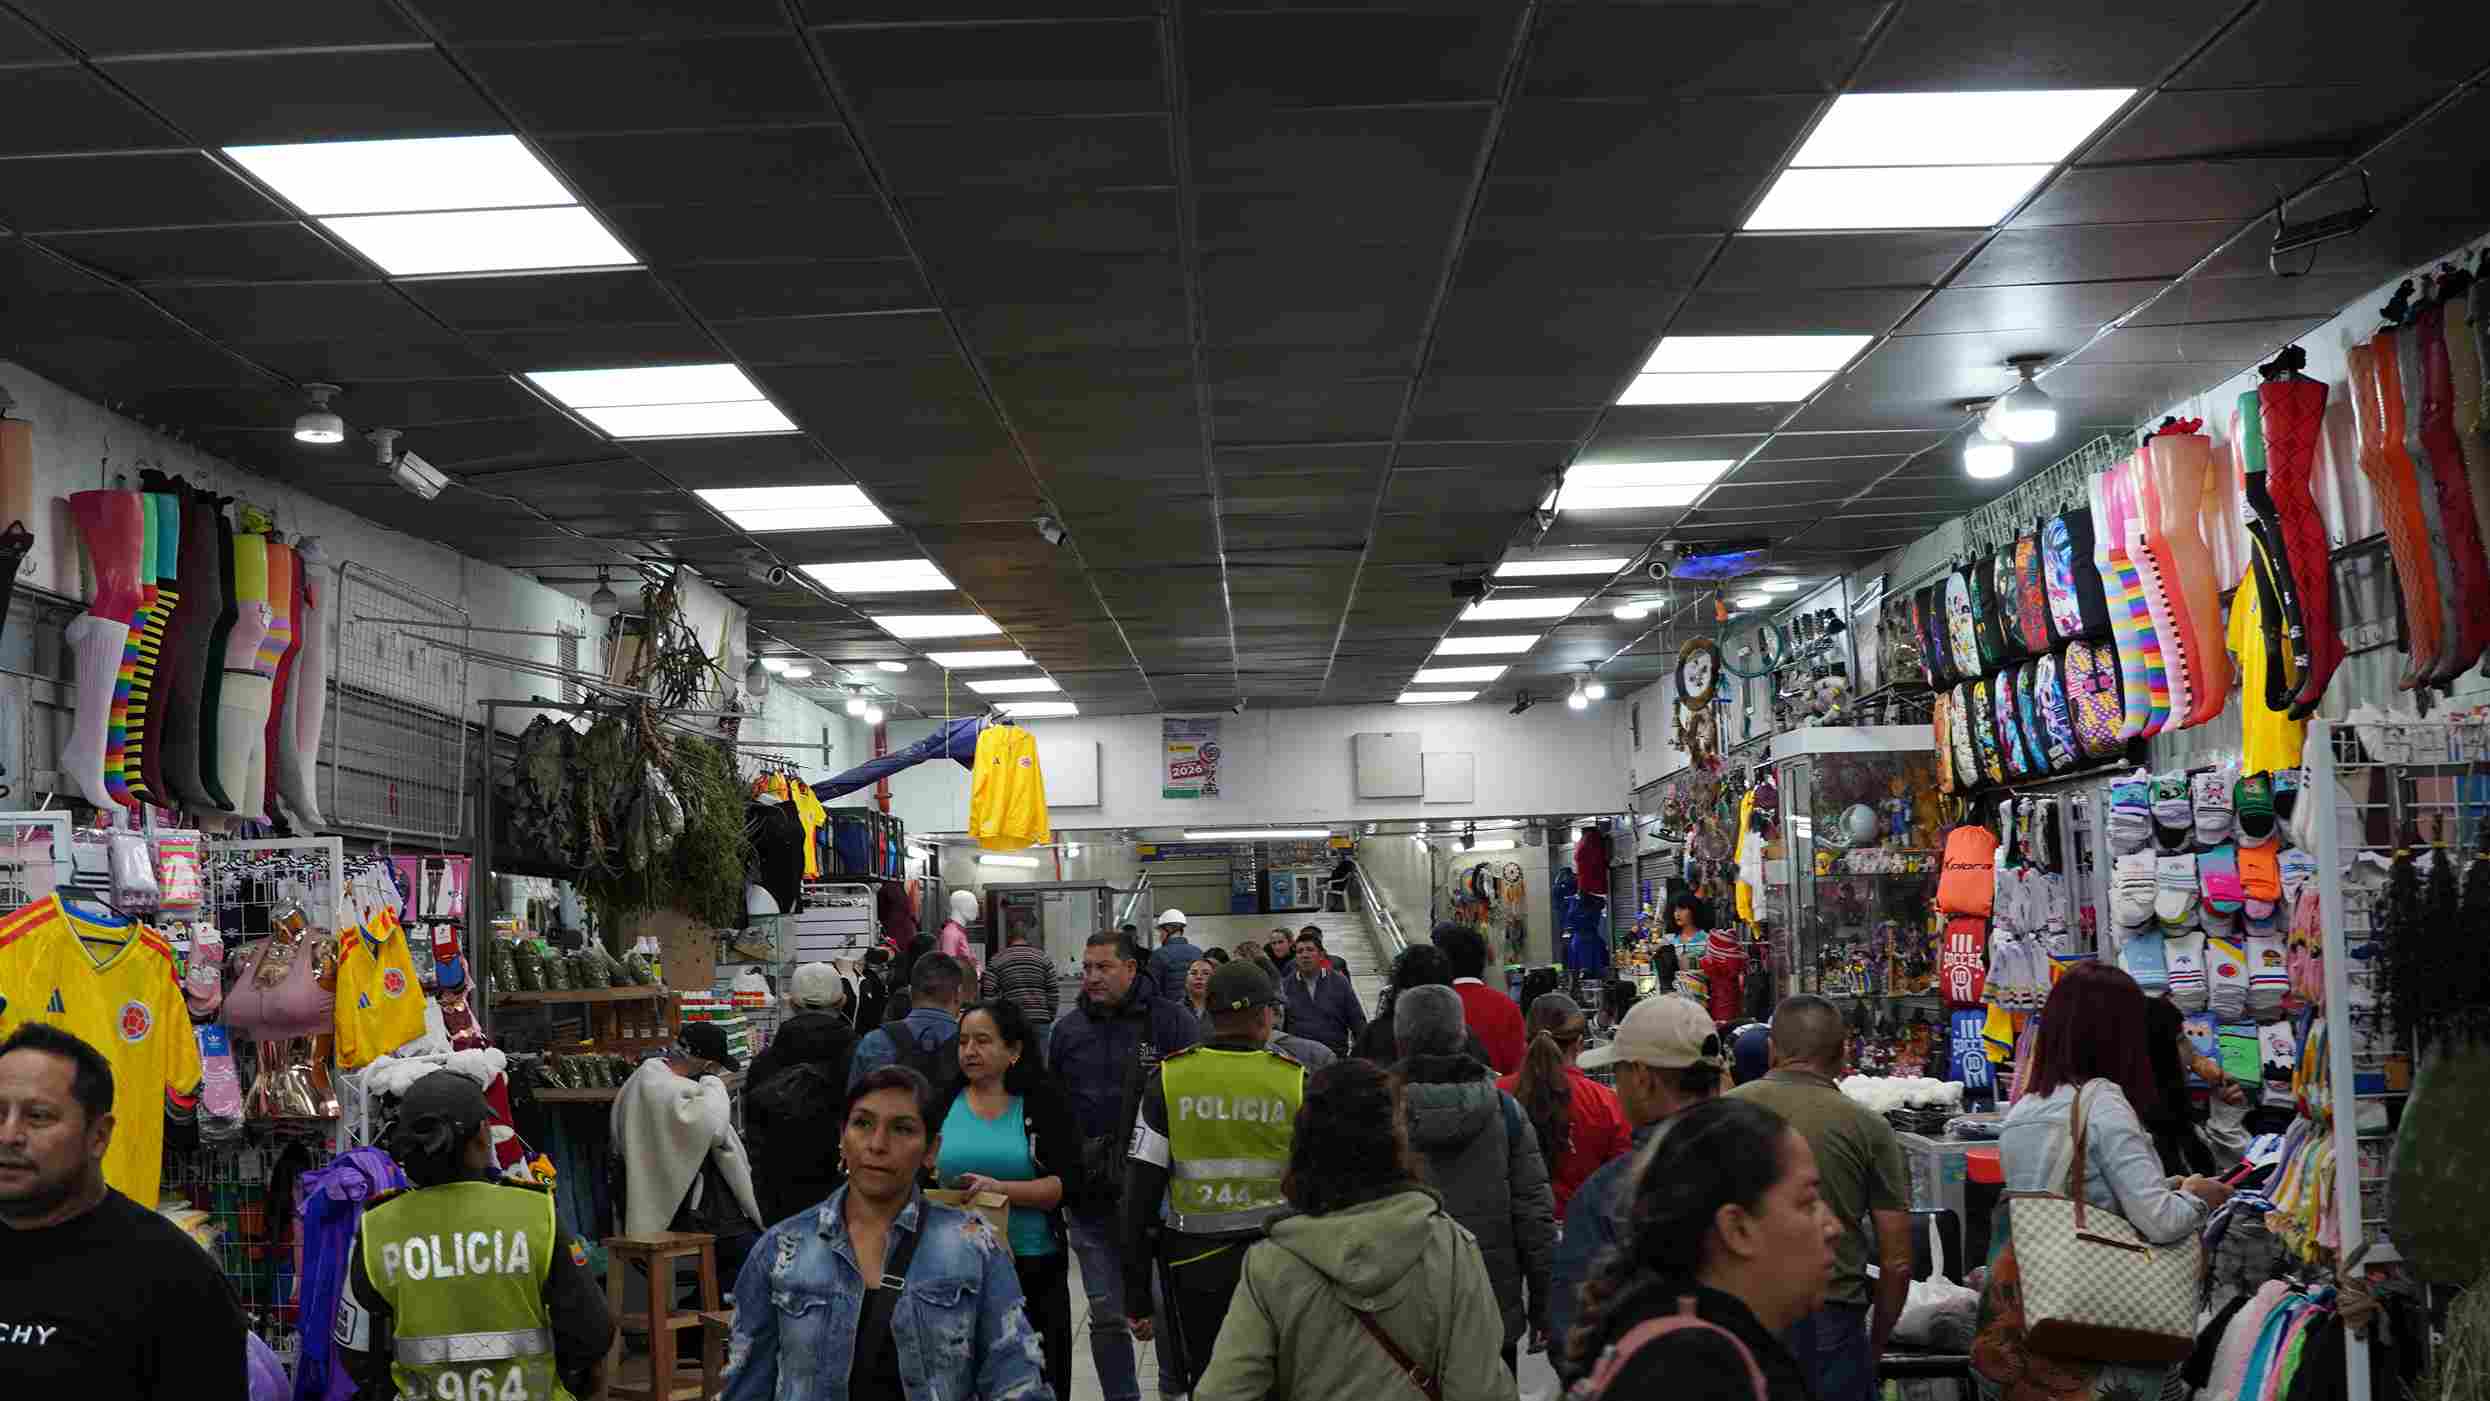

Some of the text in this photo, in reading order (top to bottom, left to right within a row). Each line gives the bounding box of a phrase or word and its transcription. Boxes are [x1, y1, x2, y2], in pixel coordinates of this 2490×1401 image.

[1171, 764, 1202, 776] 2026
[1179, 1096, 1287, 1122] POLICIA
[383, 1230, 529, 1285] POLICIA
